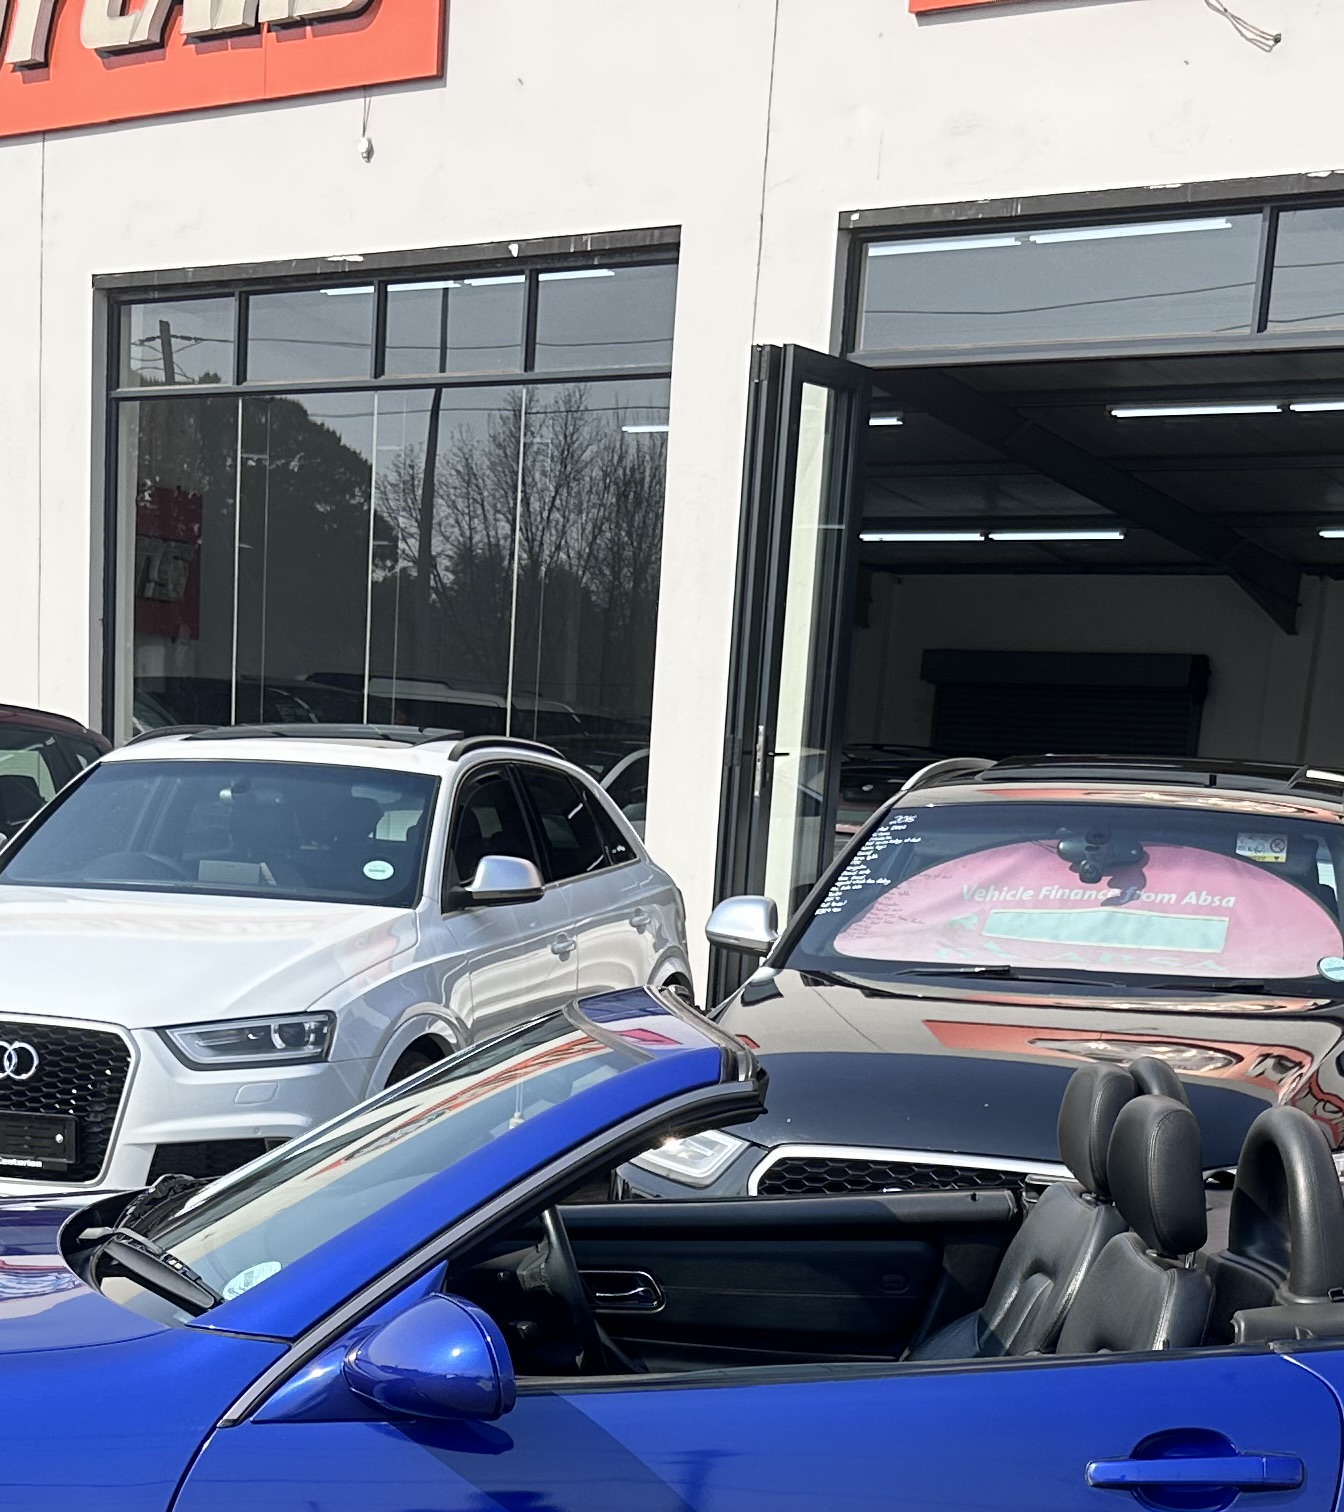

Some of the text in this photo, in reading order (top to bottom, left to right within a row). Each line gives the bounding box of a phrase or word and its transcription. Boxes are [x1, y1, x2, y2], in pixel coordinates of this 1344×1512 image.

[961, 883, 1236, 908] Vehicle Finance from Absa
